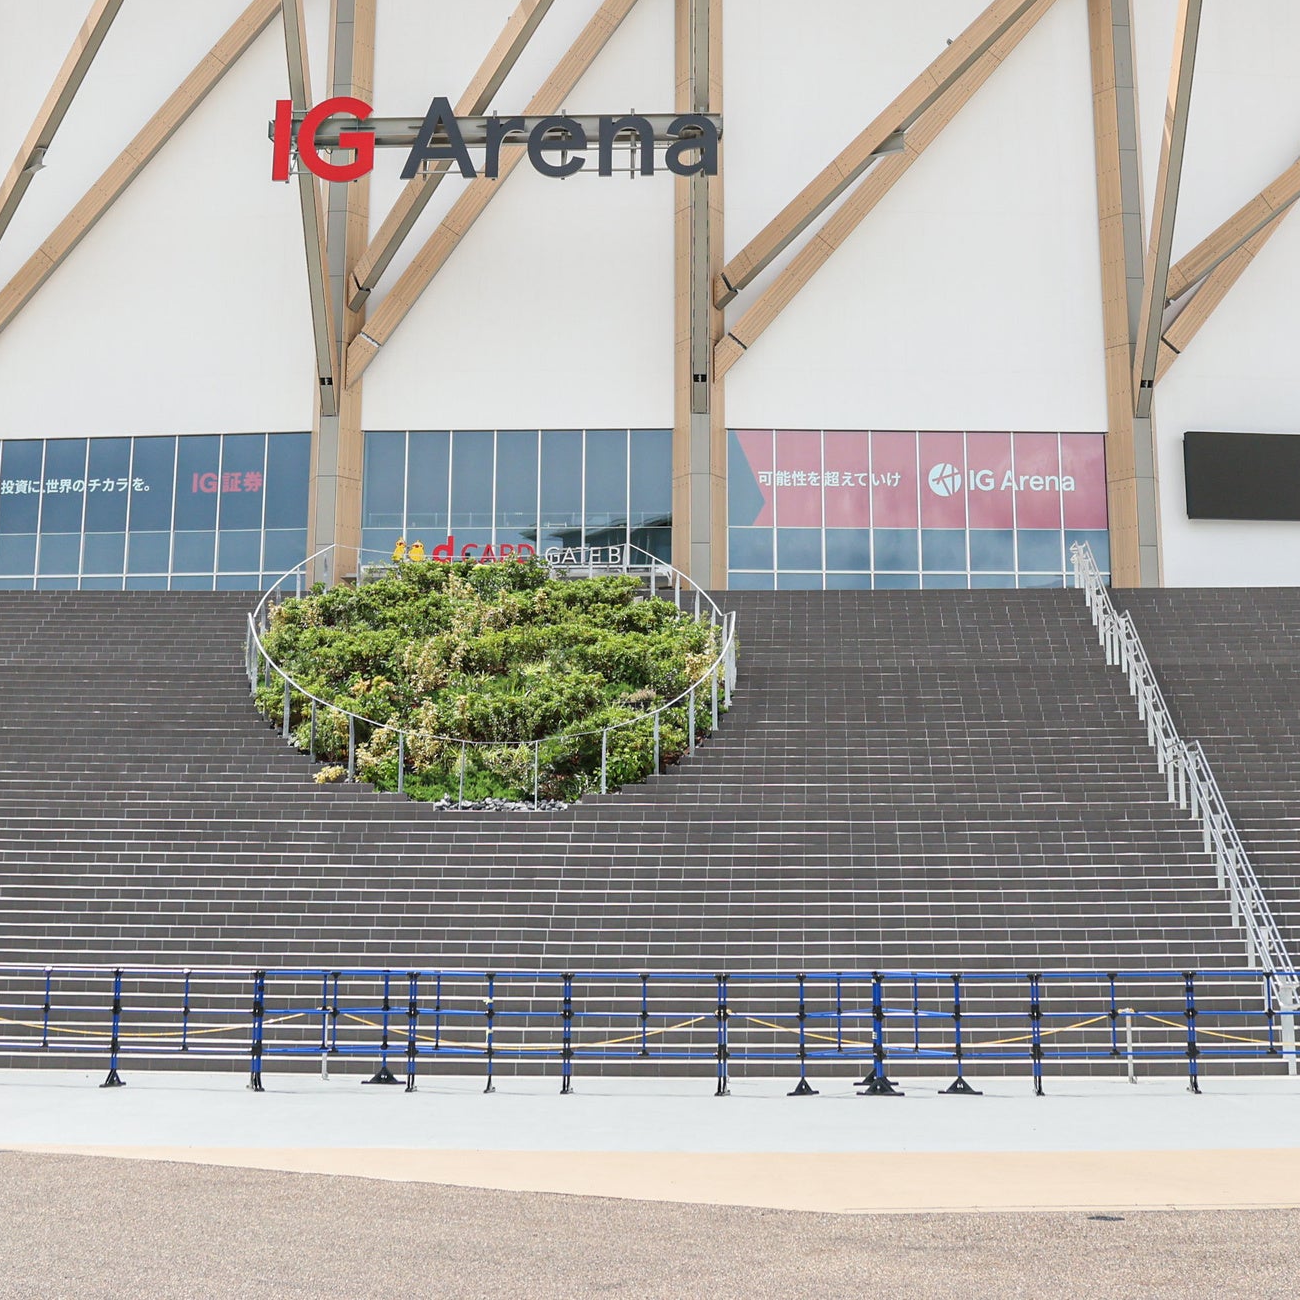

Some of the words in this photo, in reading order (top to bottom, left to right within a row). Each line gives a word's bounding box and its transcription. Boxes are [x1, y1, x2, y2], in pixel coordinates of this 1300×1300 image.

[272, 96, 375, 182] IG
[400, 96, 718, 178] Arena
[192, 471, 264, 493] IG証券
[757, 470, 901, 487] 可能性を超えていけ
[969, 469, 995, 491] IG
[1001, 469, 1076, 491] Arena
[545, 547, 602, 565] GATE
[608, 548, 621, 565] B
